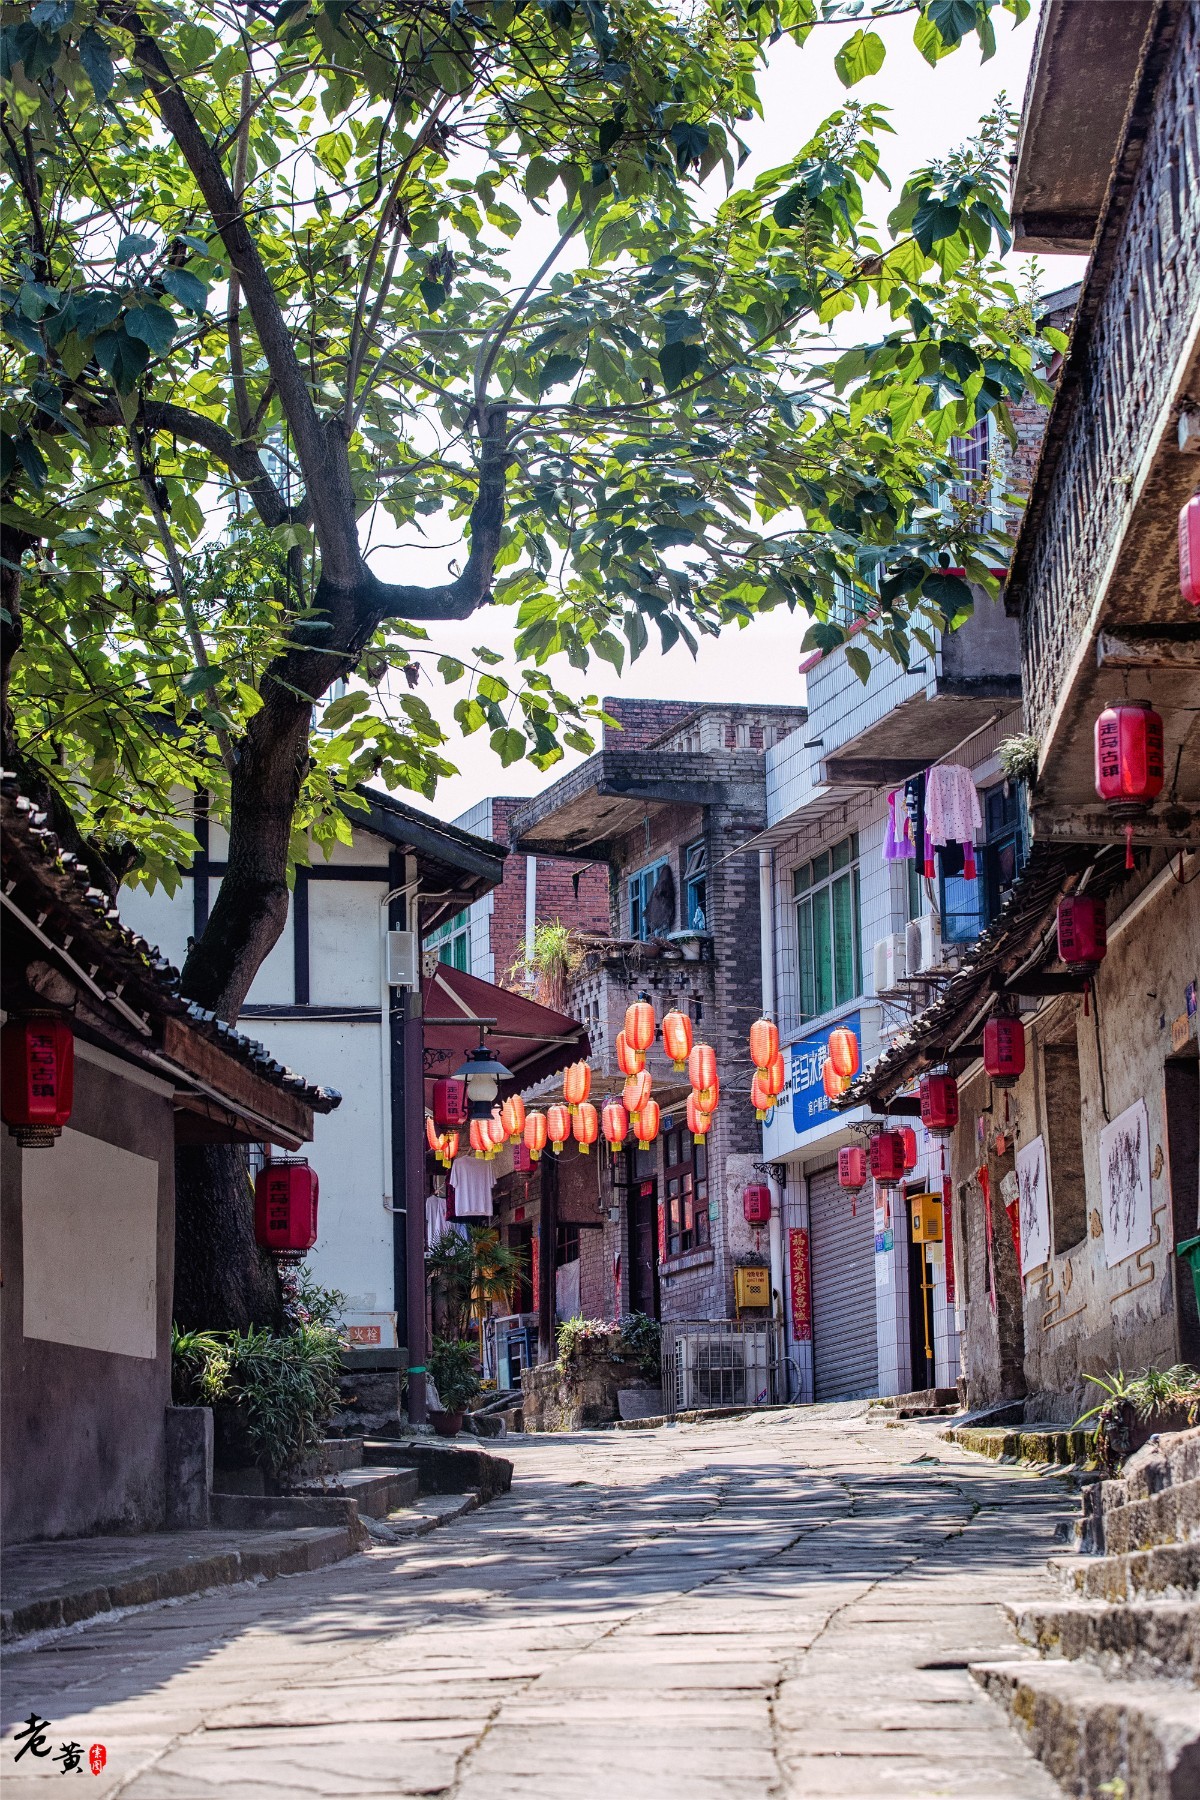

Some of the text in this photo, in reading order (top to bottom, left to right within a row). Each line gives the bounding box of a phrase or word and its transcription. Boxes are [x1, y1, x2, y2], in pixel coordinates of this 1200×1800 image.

[1100, 723, 1119, 777] 走马古镇
[31, 1035, 55, 1097] 走马古镇
[269, 1181, 289, 1230] 走马古镇
